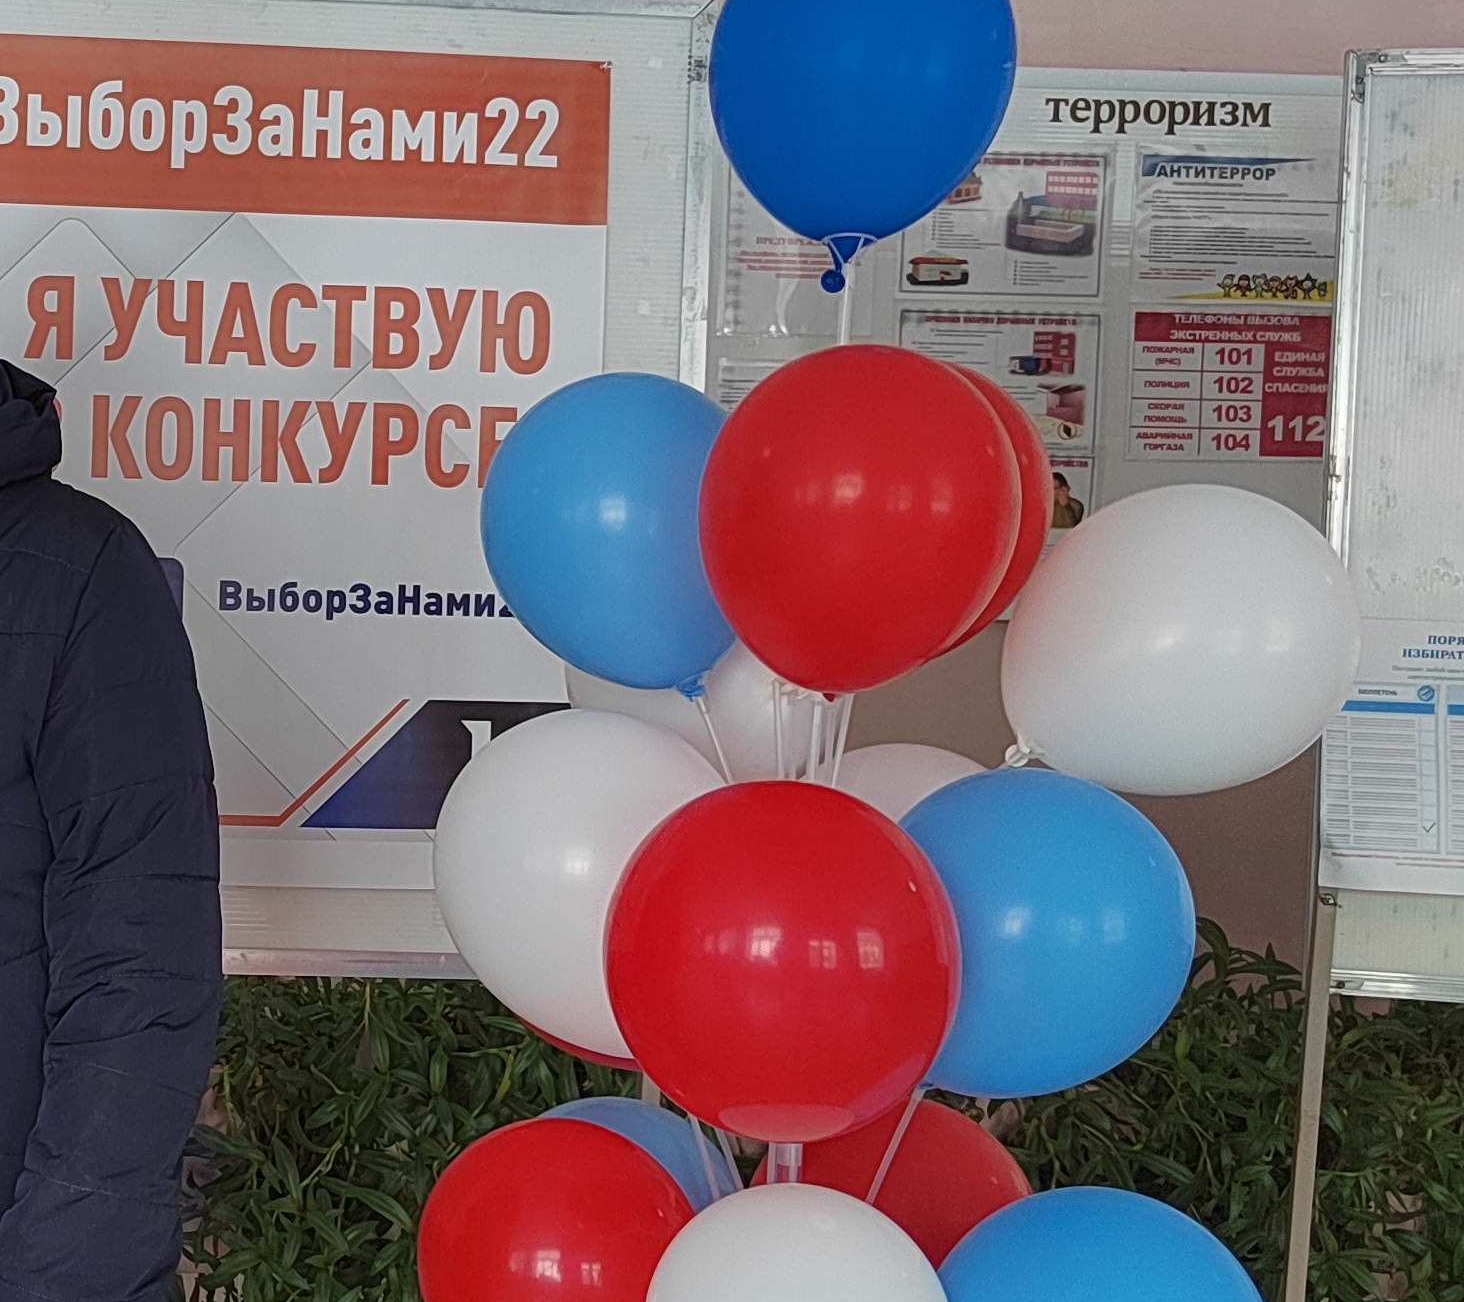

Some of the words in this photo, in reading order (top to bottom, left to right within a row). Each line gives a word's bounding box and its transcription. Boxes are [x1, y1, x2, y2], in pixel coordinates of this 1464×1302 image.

[1044, 97, 1273, 136] терроризм
[1156, 164, 1277, 181] АНТИТЕРРОР
[23, 275, 76, 361] Я
[100, 276, 552, 376] УЧАСТВУЮ
[1174, 314, 1244, 325] ТЕЛЕФОНЫ
[1247, 315, 1300, 326] ВЫЗОВА
[1169, 330, 1253, 341] ЭКСТРЕННЫХ
[1256, 331, 1302, 342] СЛУЖБ
[1142, 346, 1195, 354] ПОЖАРНАЯ
[1214, 347, 1253, 366] 101
[1274, 352, 1326, 362] ЕДИНАЯ
[1272, 366, 1325, 377] СЛУЖБА
[1143, 380, 1190, 389] ПОЛИЦИЯ
[1212, 376, 1254, 394] 102
[1264, 382, 1328, 394] СПАСЕНИЯ
[1147, 403, 1185, 411] СКОРАЯ
[1143, 415, 1187, 424] ПОМОЩЬ
[1211, 404, 1252, 423] 103
[1266, 415, 1327, 442] 112
[1142, 442, 1185, 451] ГОРГАЗА
[1210, 433, 1251, 452] 104
